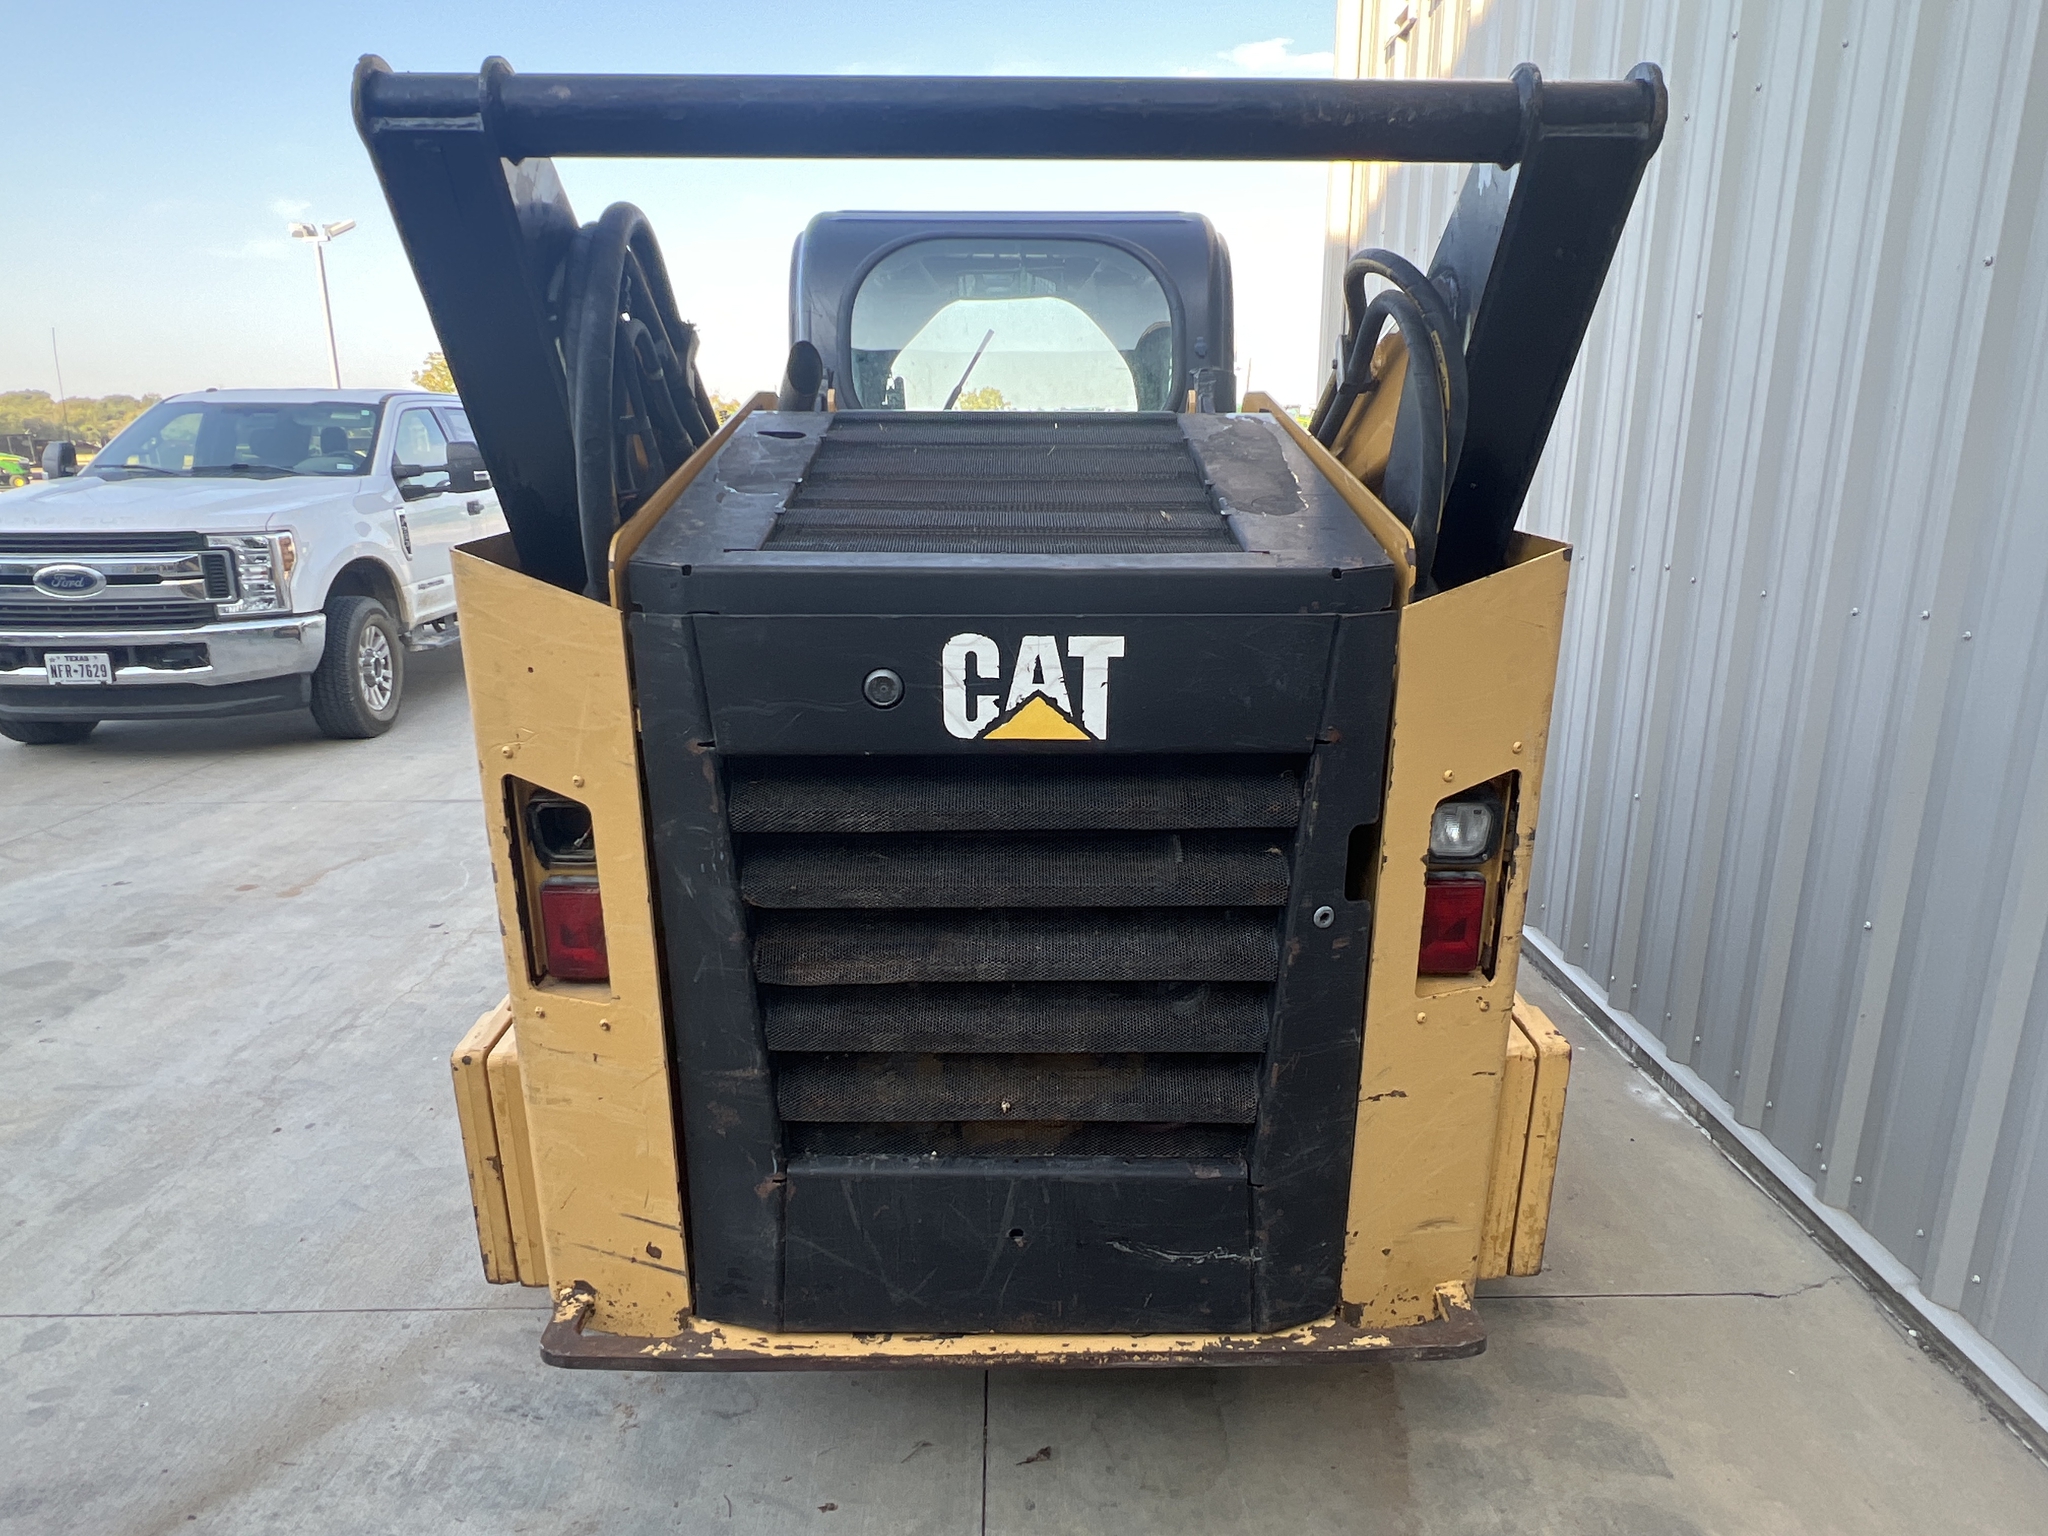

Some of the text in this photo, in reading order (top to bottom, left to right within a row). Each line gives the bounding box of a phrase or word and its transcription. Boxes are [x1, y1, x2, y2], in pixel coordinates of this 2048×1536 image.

[51, 573, 85, 588] Ford
[50, 664, 108, 678] NFR-7629
[942, 633, 1125, 740] CAT
